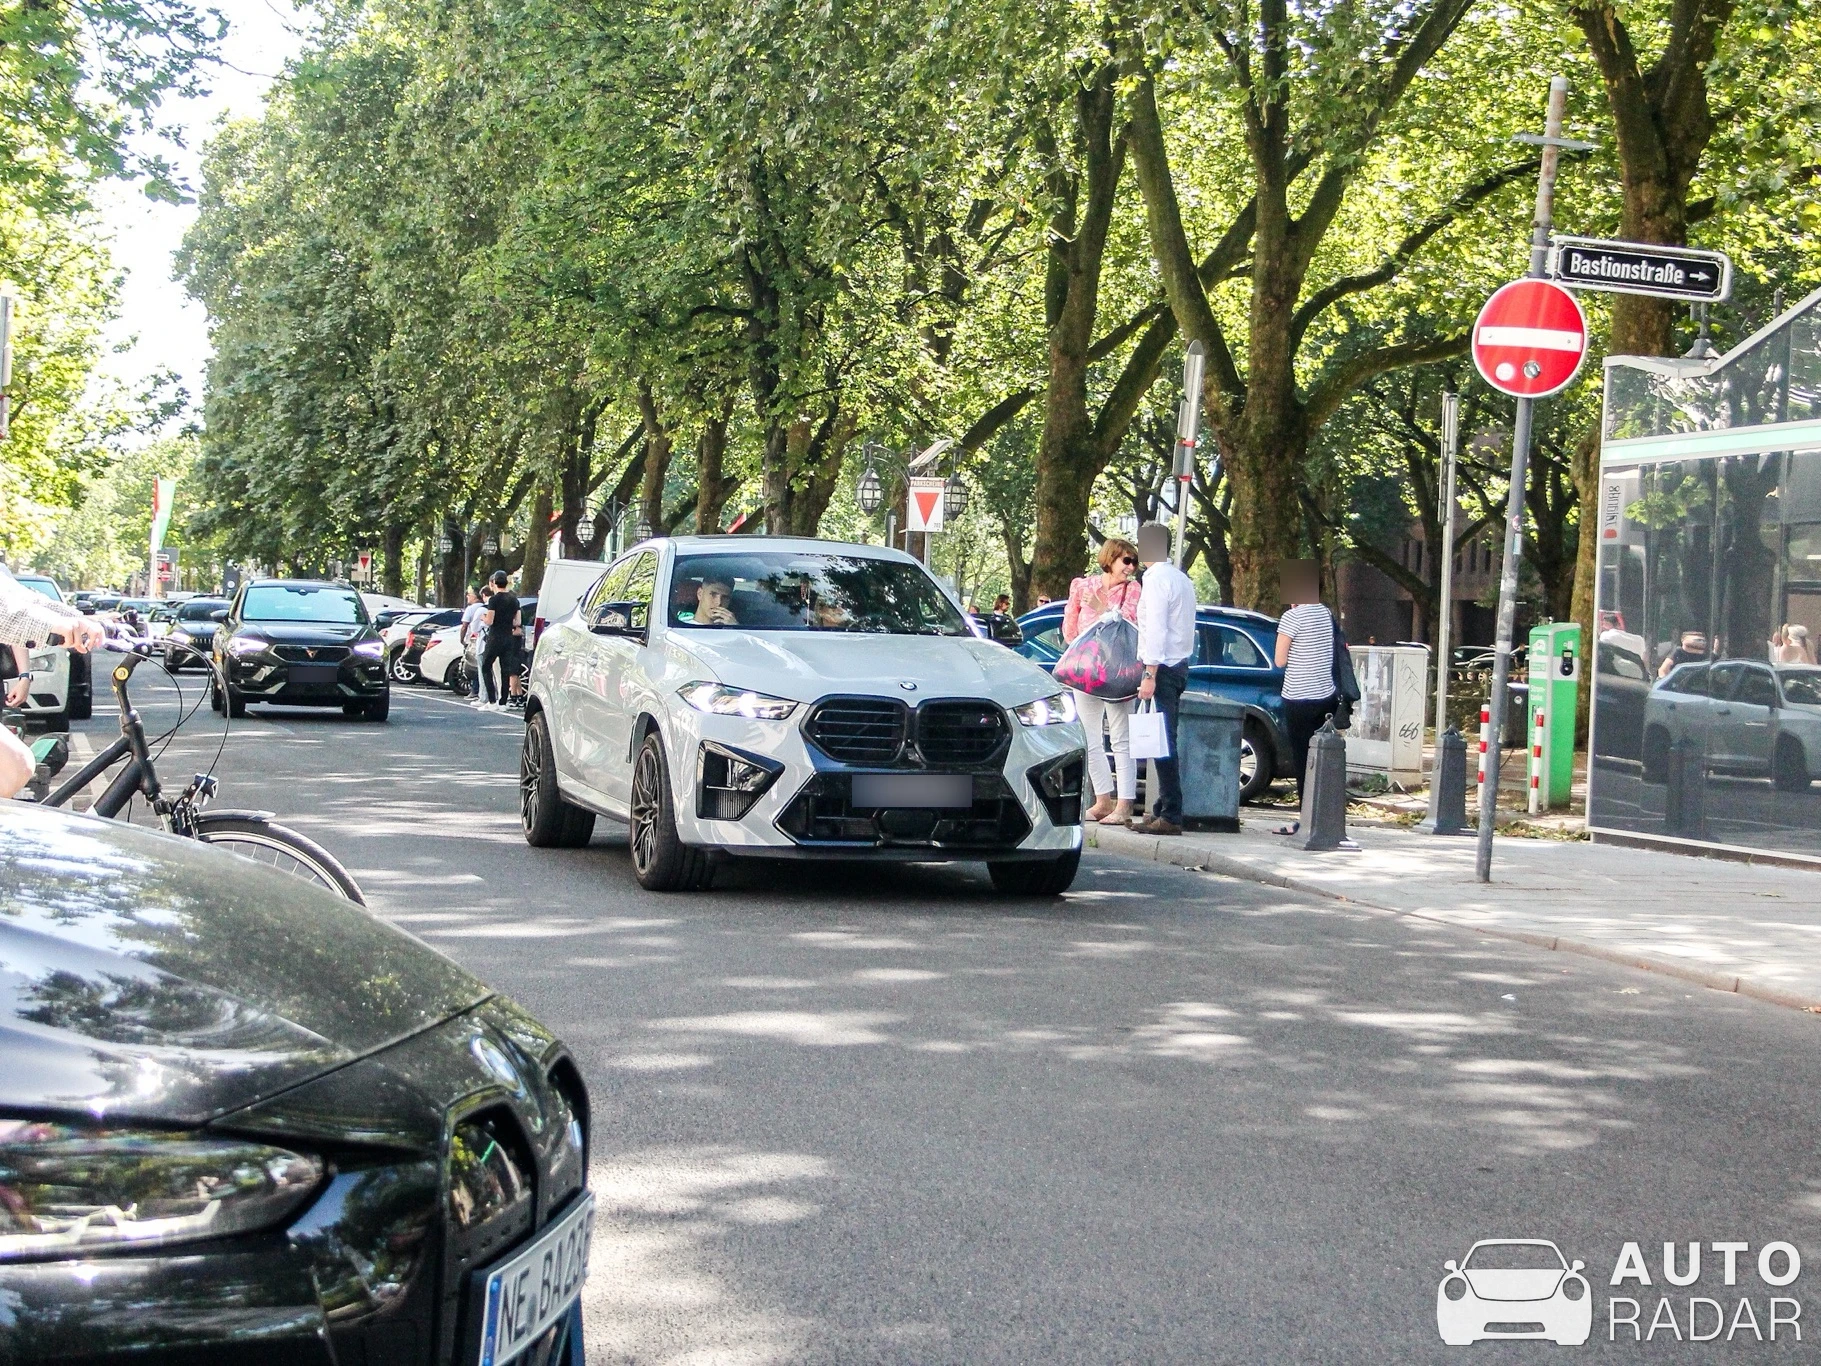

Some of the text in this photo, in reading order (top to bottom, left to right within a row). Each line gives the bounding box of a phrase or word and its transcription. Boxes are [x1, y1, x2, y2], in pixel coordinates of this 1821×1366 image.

[1570, 252, 1685, 284] Bastionstraße
[1399, 722, 1420, 740] 666
[498, 1266, 530, 1353] NE
